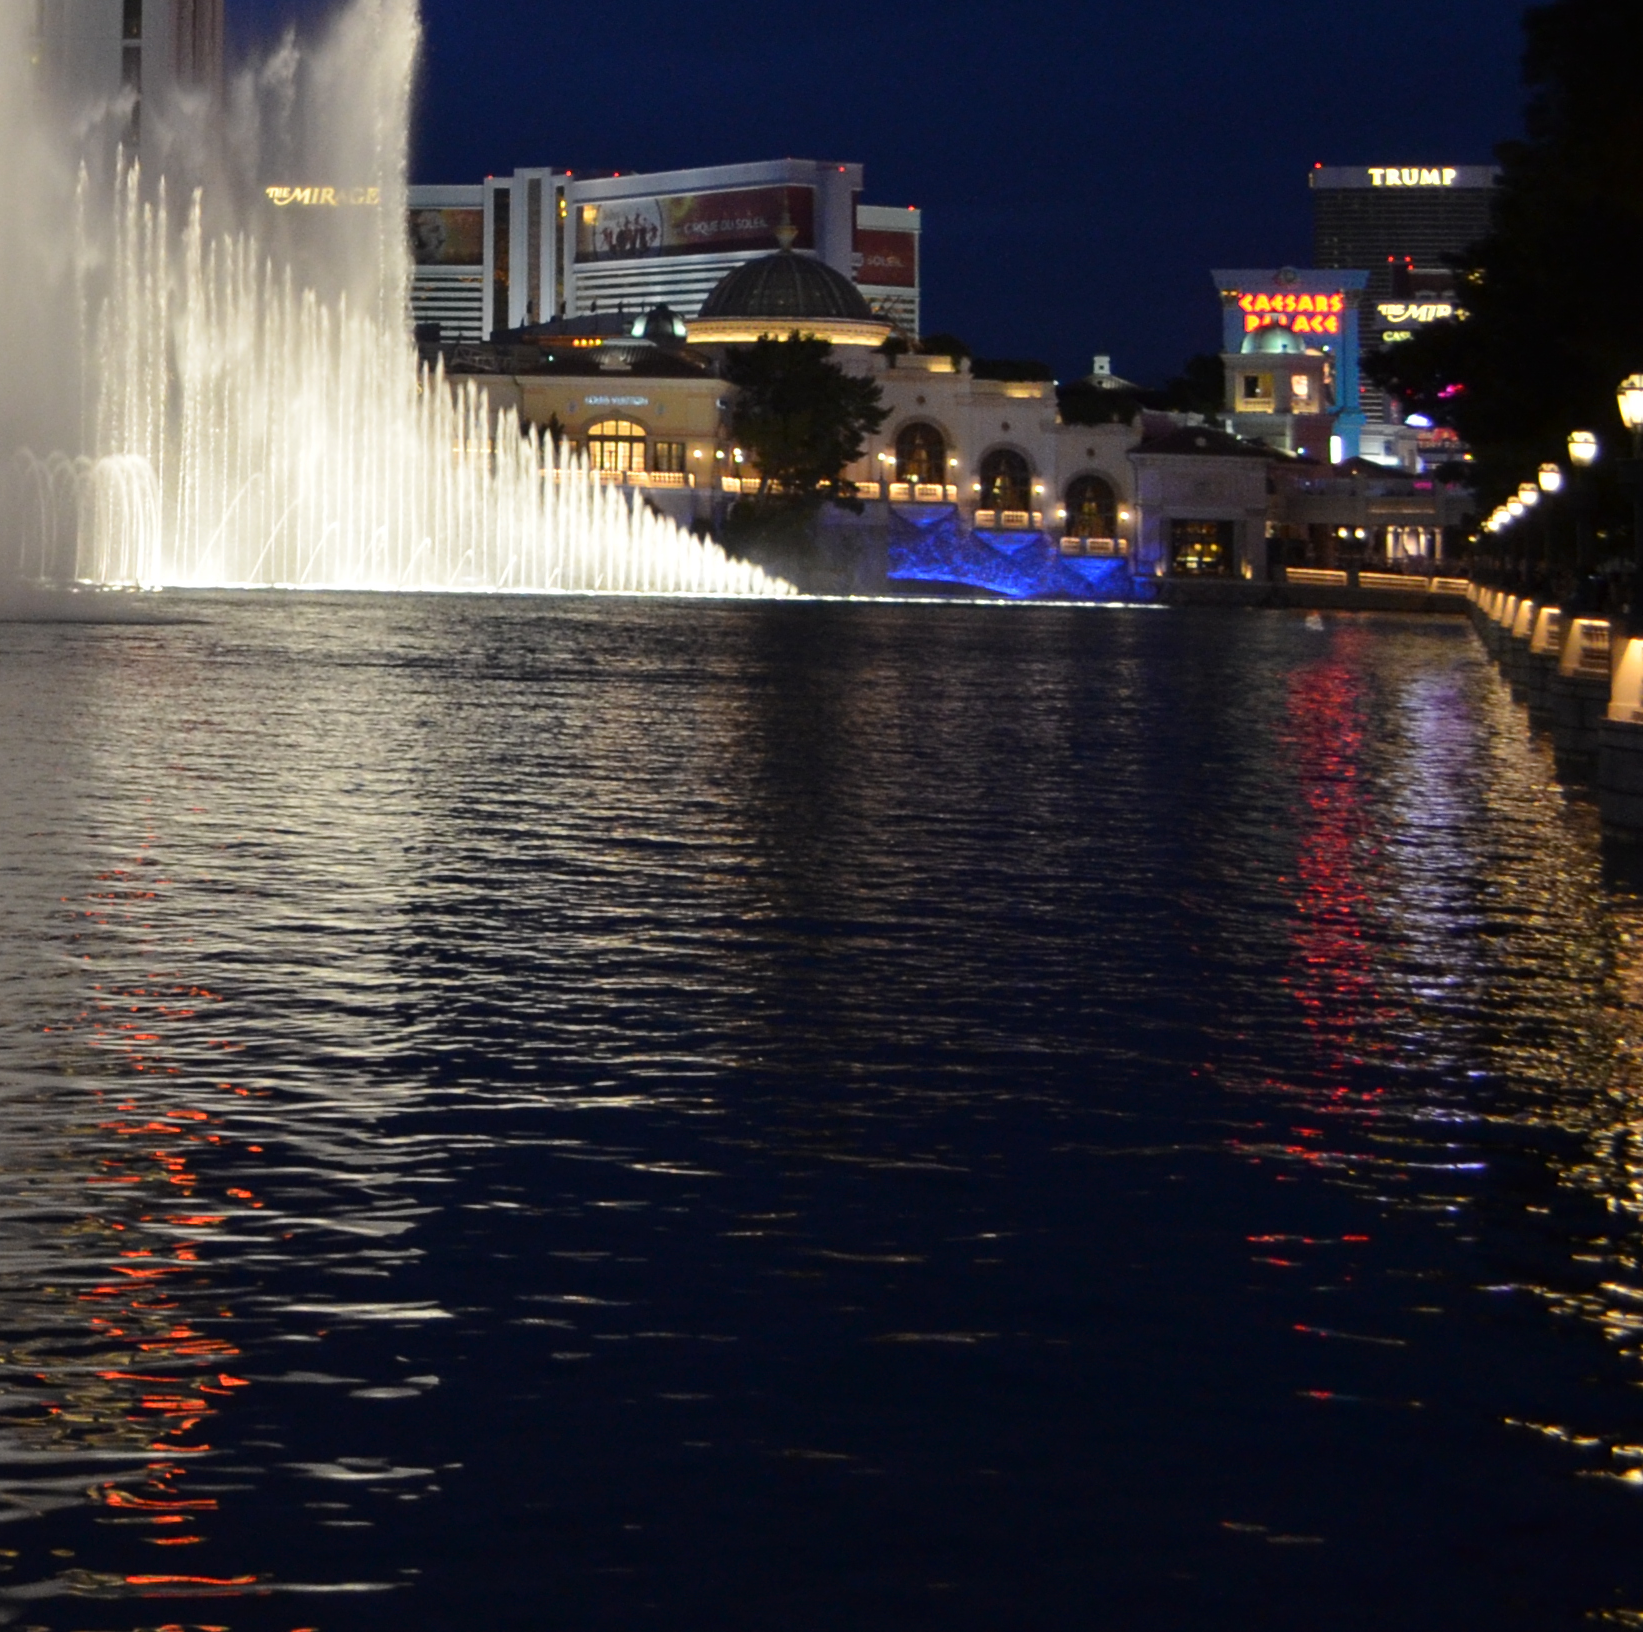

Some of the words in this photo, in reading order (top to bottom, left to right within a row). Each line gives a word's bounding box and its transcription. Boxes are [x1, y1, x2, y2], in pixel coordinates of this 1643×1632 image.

[1367, 167, 1457, 186] TRUMP
[266, 186, 291, 198] THE
[1238, 292, 1344, 313] CAESARS
